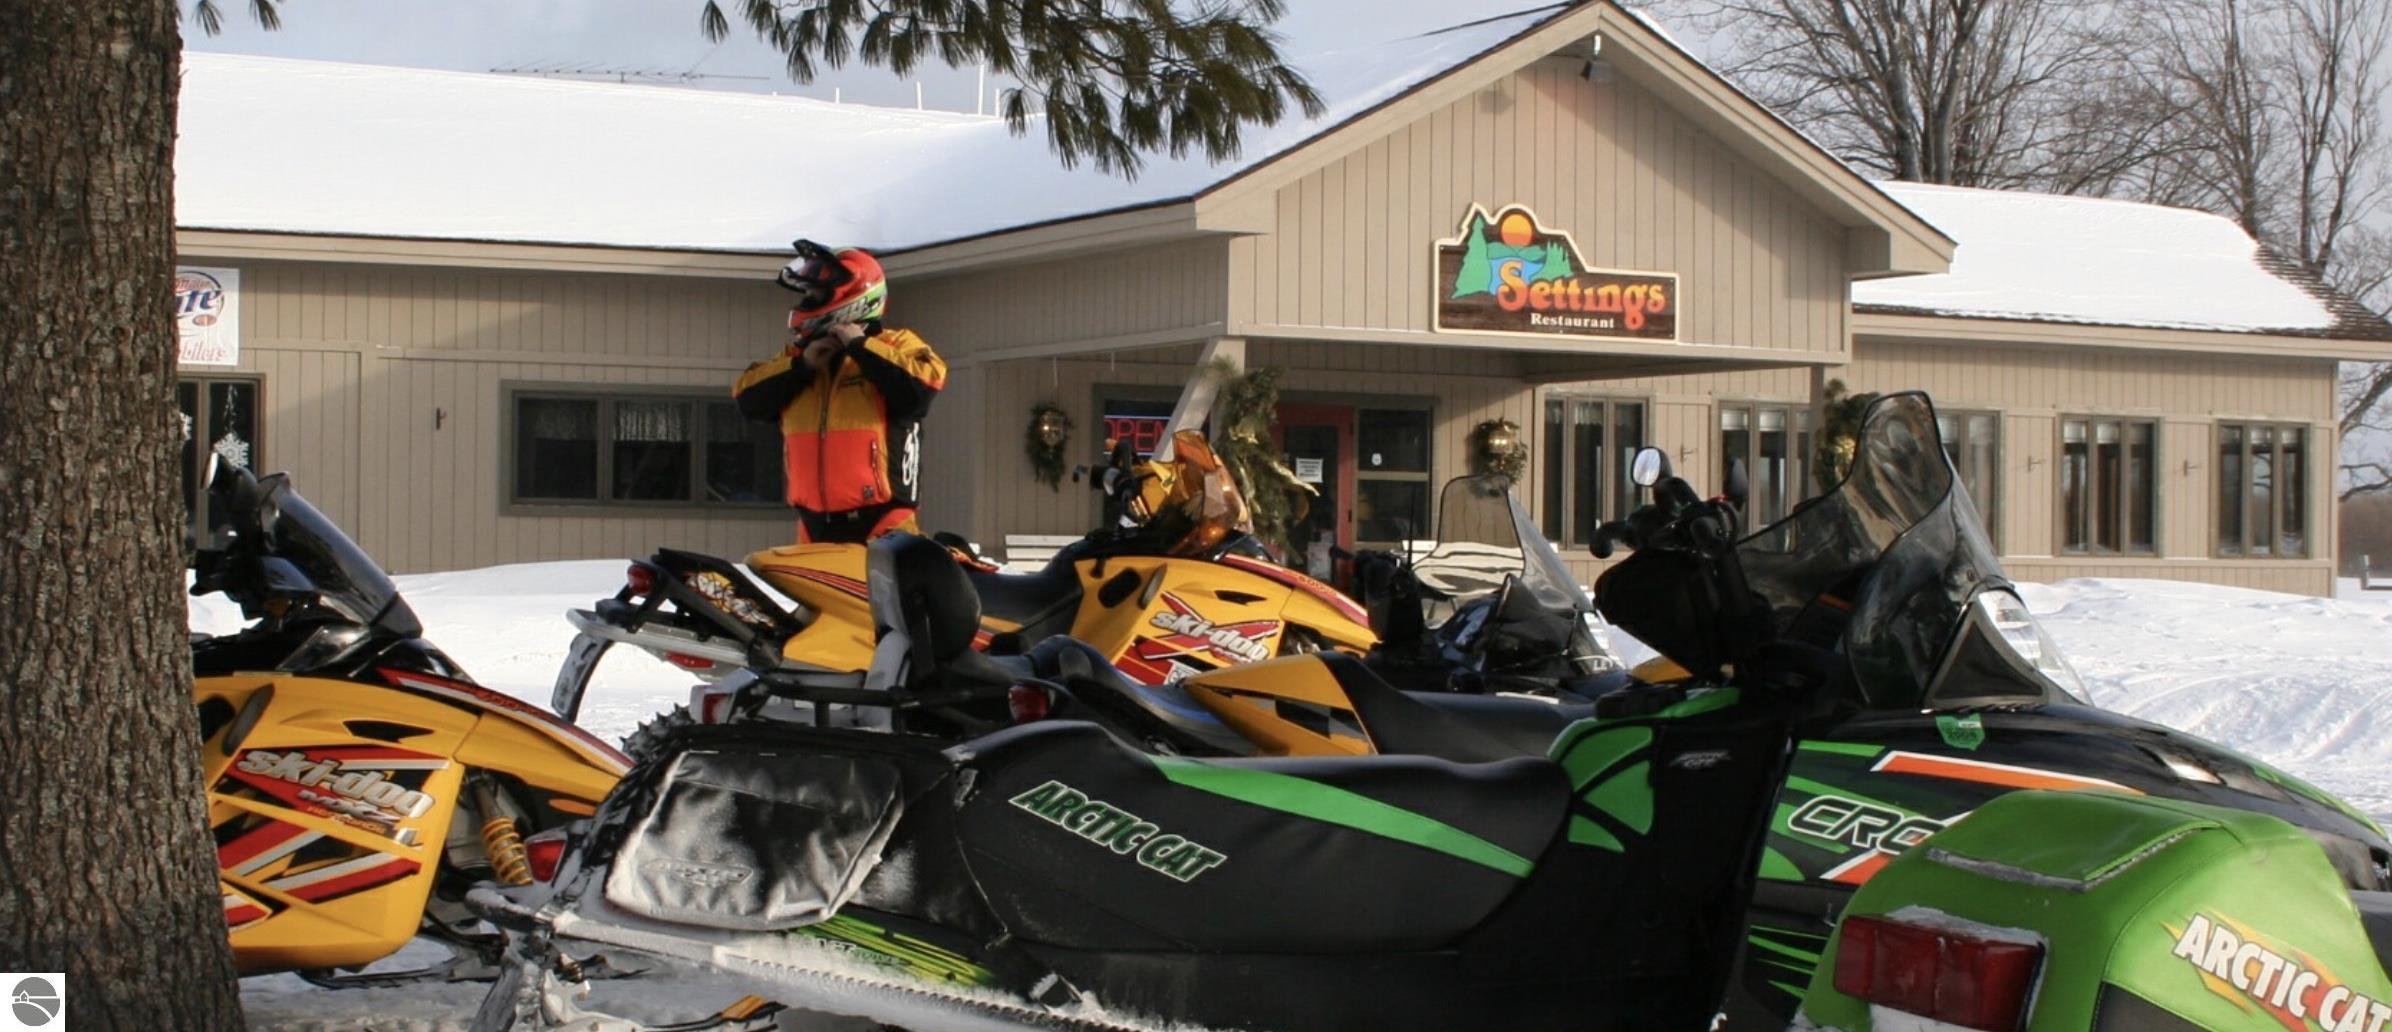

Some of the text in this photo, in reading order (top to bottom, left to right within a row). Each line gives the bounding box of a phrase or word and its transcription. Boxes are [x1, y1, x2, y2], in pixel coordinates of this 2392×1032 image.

[175, 288, 223, 313] ite
[1497, 260, 1666, 330] Settings
[1530, 312, 1615, 329] Restaurant
[1008, 779, 1228, 883] ARCTIC CAT
[2172, 912, 2392, 1032] ARCTIC CAT
